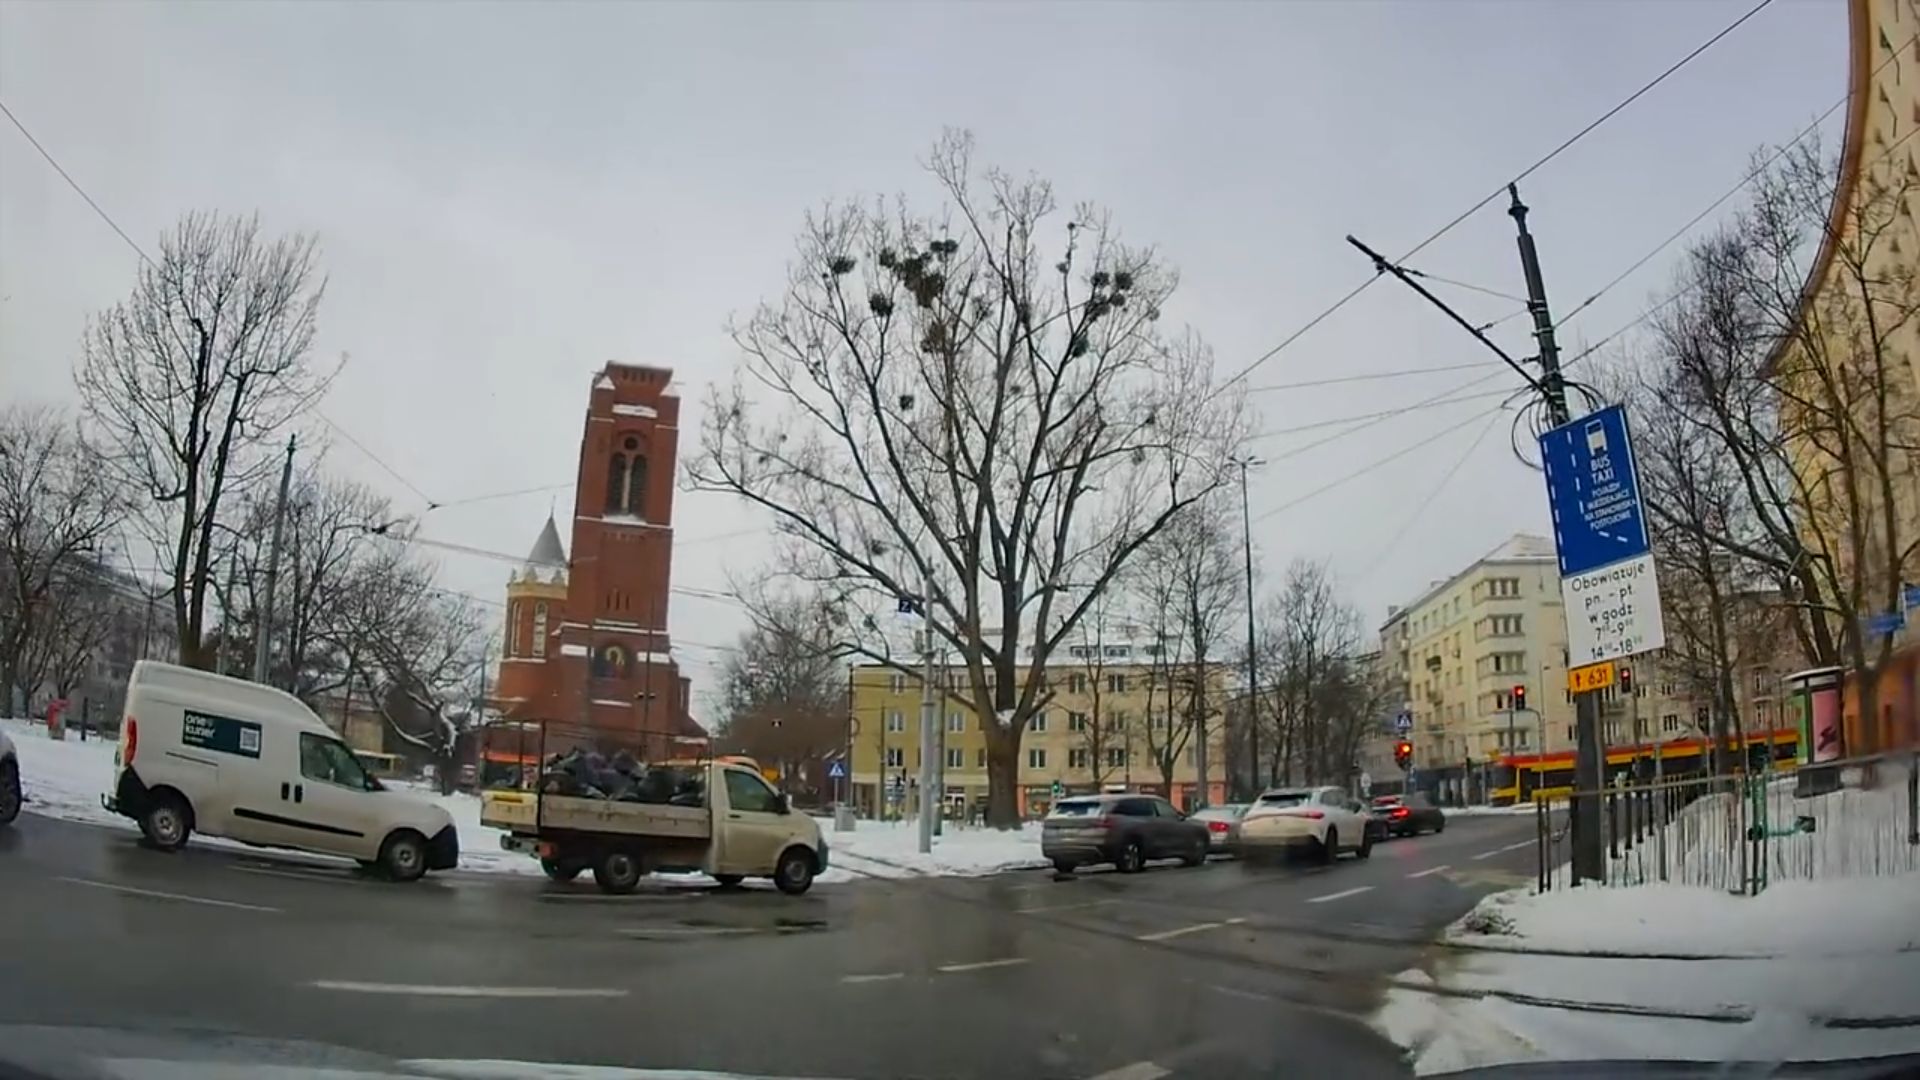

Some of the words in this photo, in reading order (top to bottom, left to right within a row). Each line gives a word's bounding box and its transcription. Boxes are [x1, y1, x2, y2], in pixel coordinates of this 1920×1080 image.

[1590, 454, 1611, 471] BUS
[1592, 467, 1614, 484] TAXI
[1588, 613, 1598, 624] w
